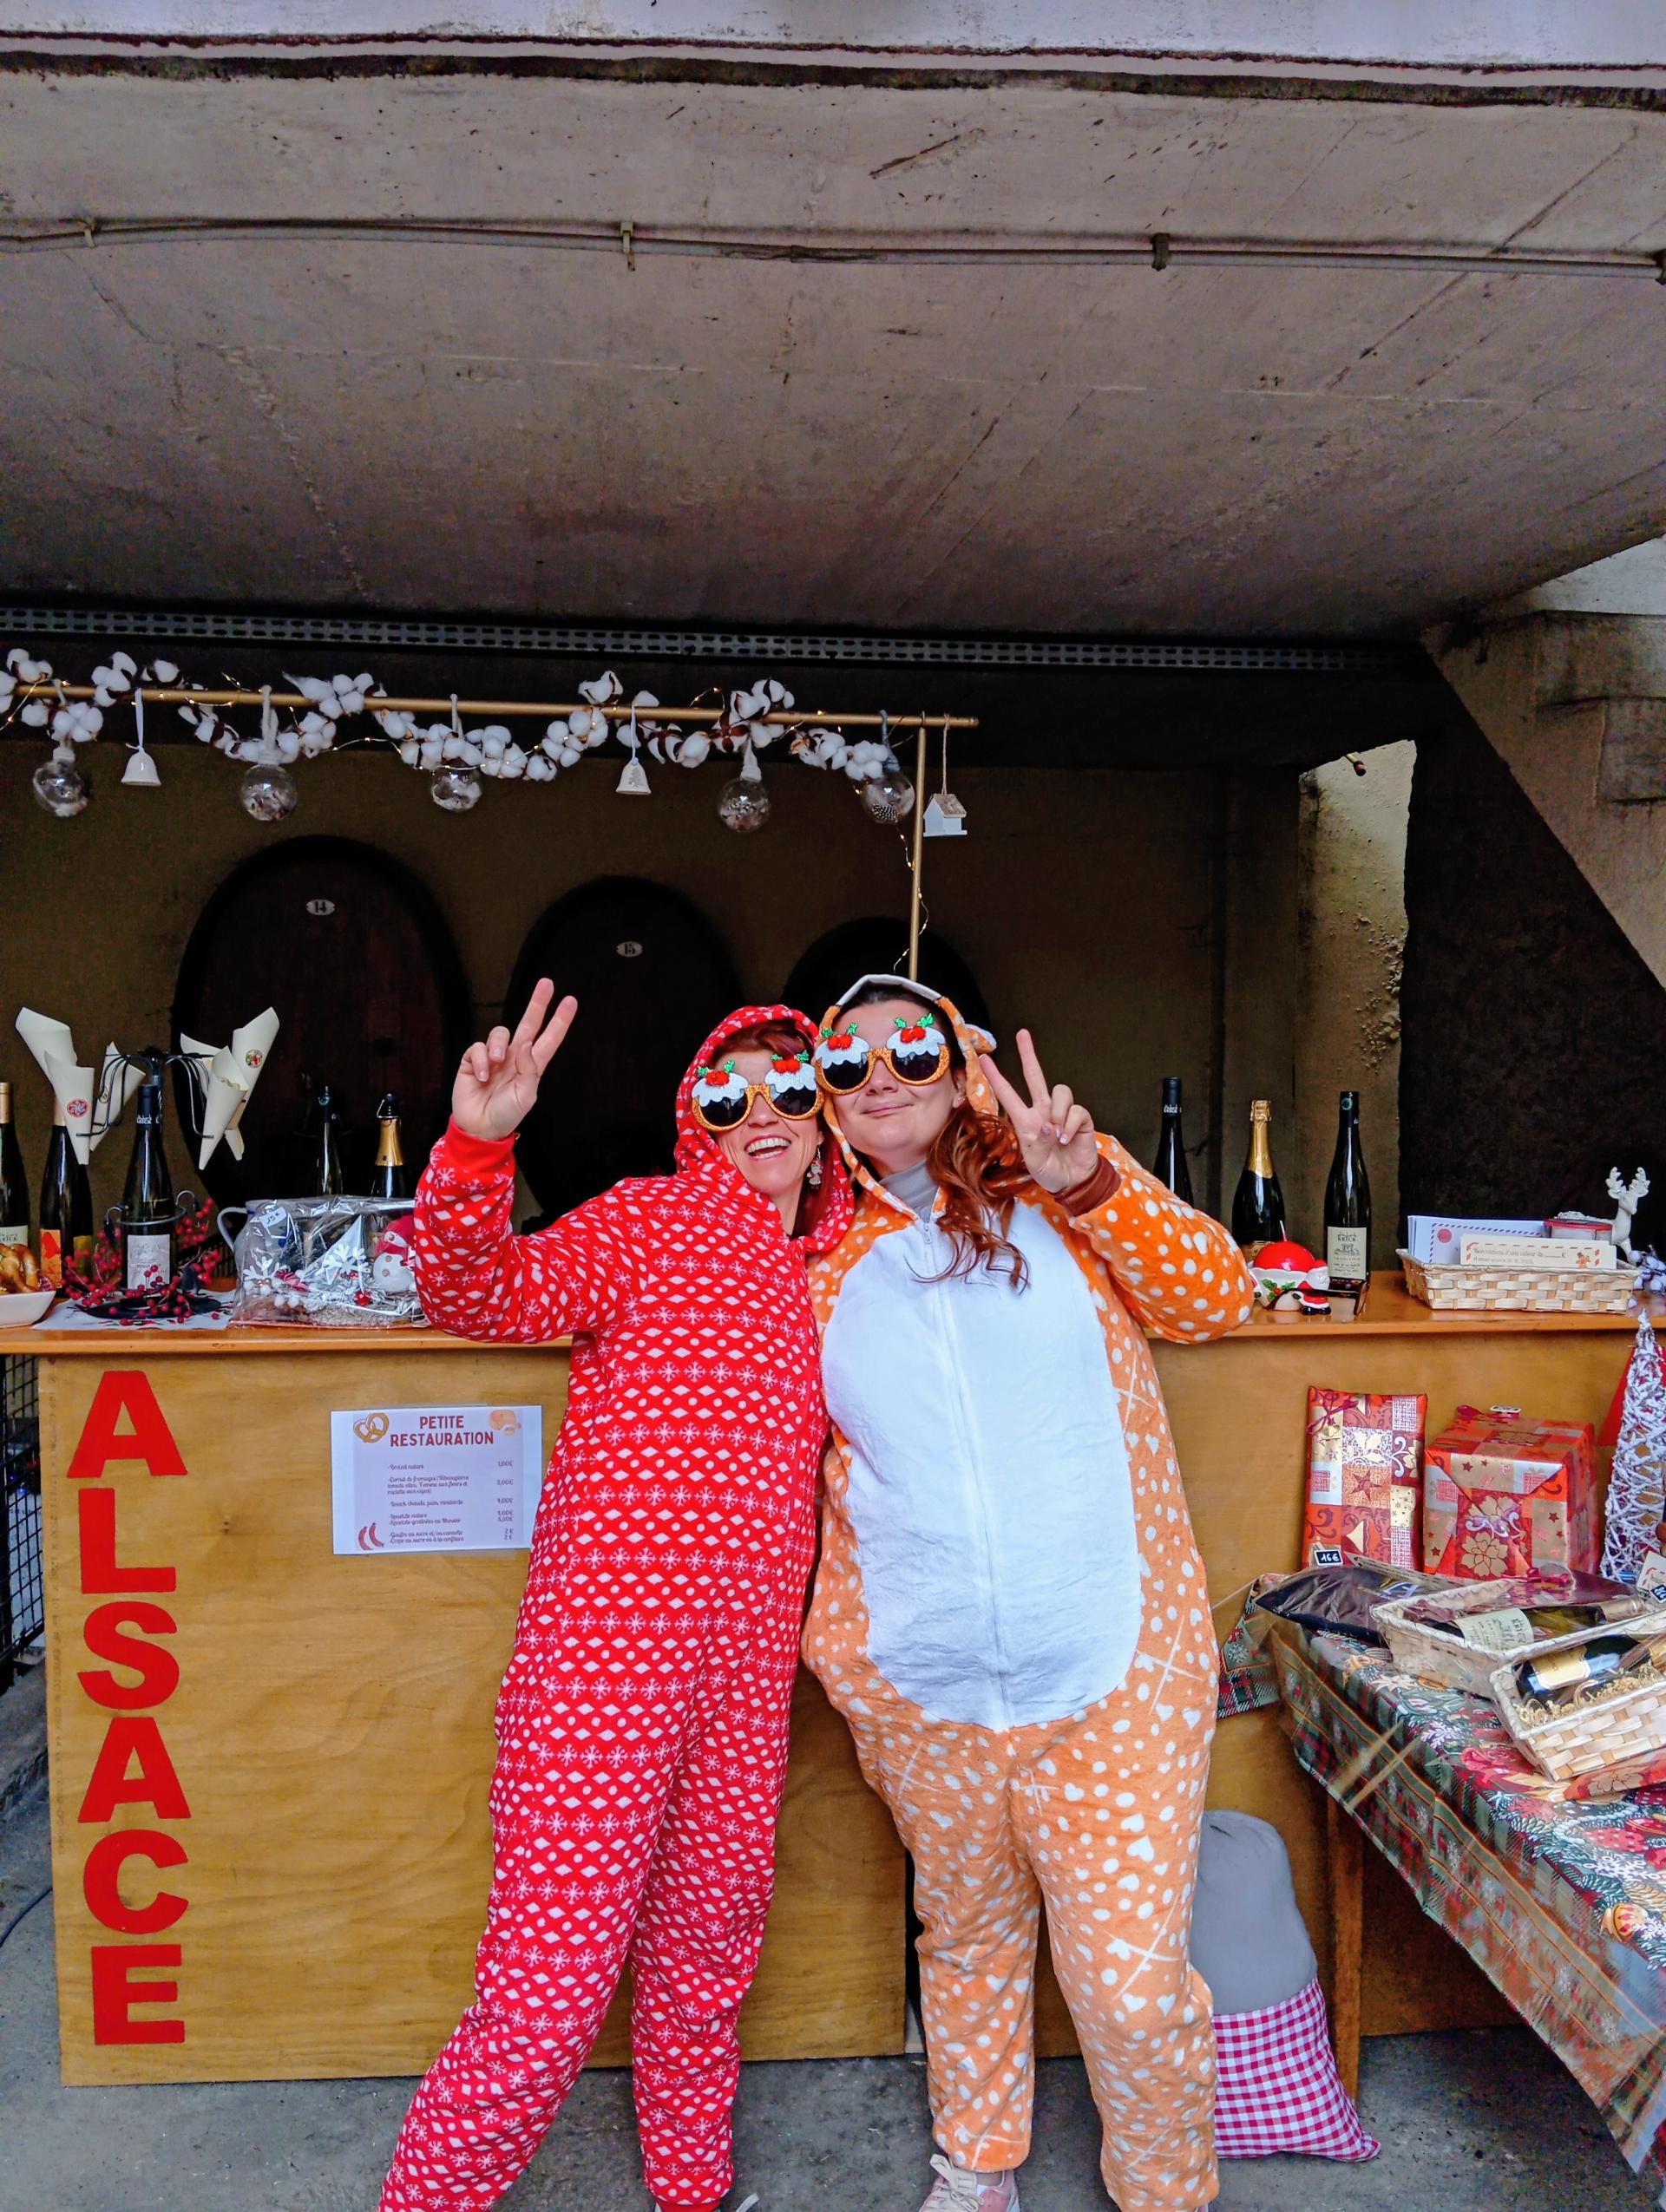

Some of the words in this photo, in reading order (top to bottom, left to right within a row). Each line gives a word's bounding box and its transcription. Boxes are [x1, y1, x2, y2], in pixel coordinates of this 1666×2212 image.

[314, 900, 327, 913] 14
[419, 1416, 464, 1430] PETITE
[390, 1431, 494, 1447] RESTAURATION
[1321, 1553, 1340, 1562] 16€
[67, 1370, 192, 2046] ALSACE
